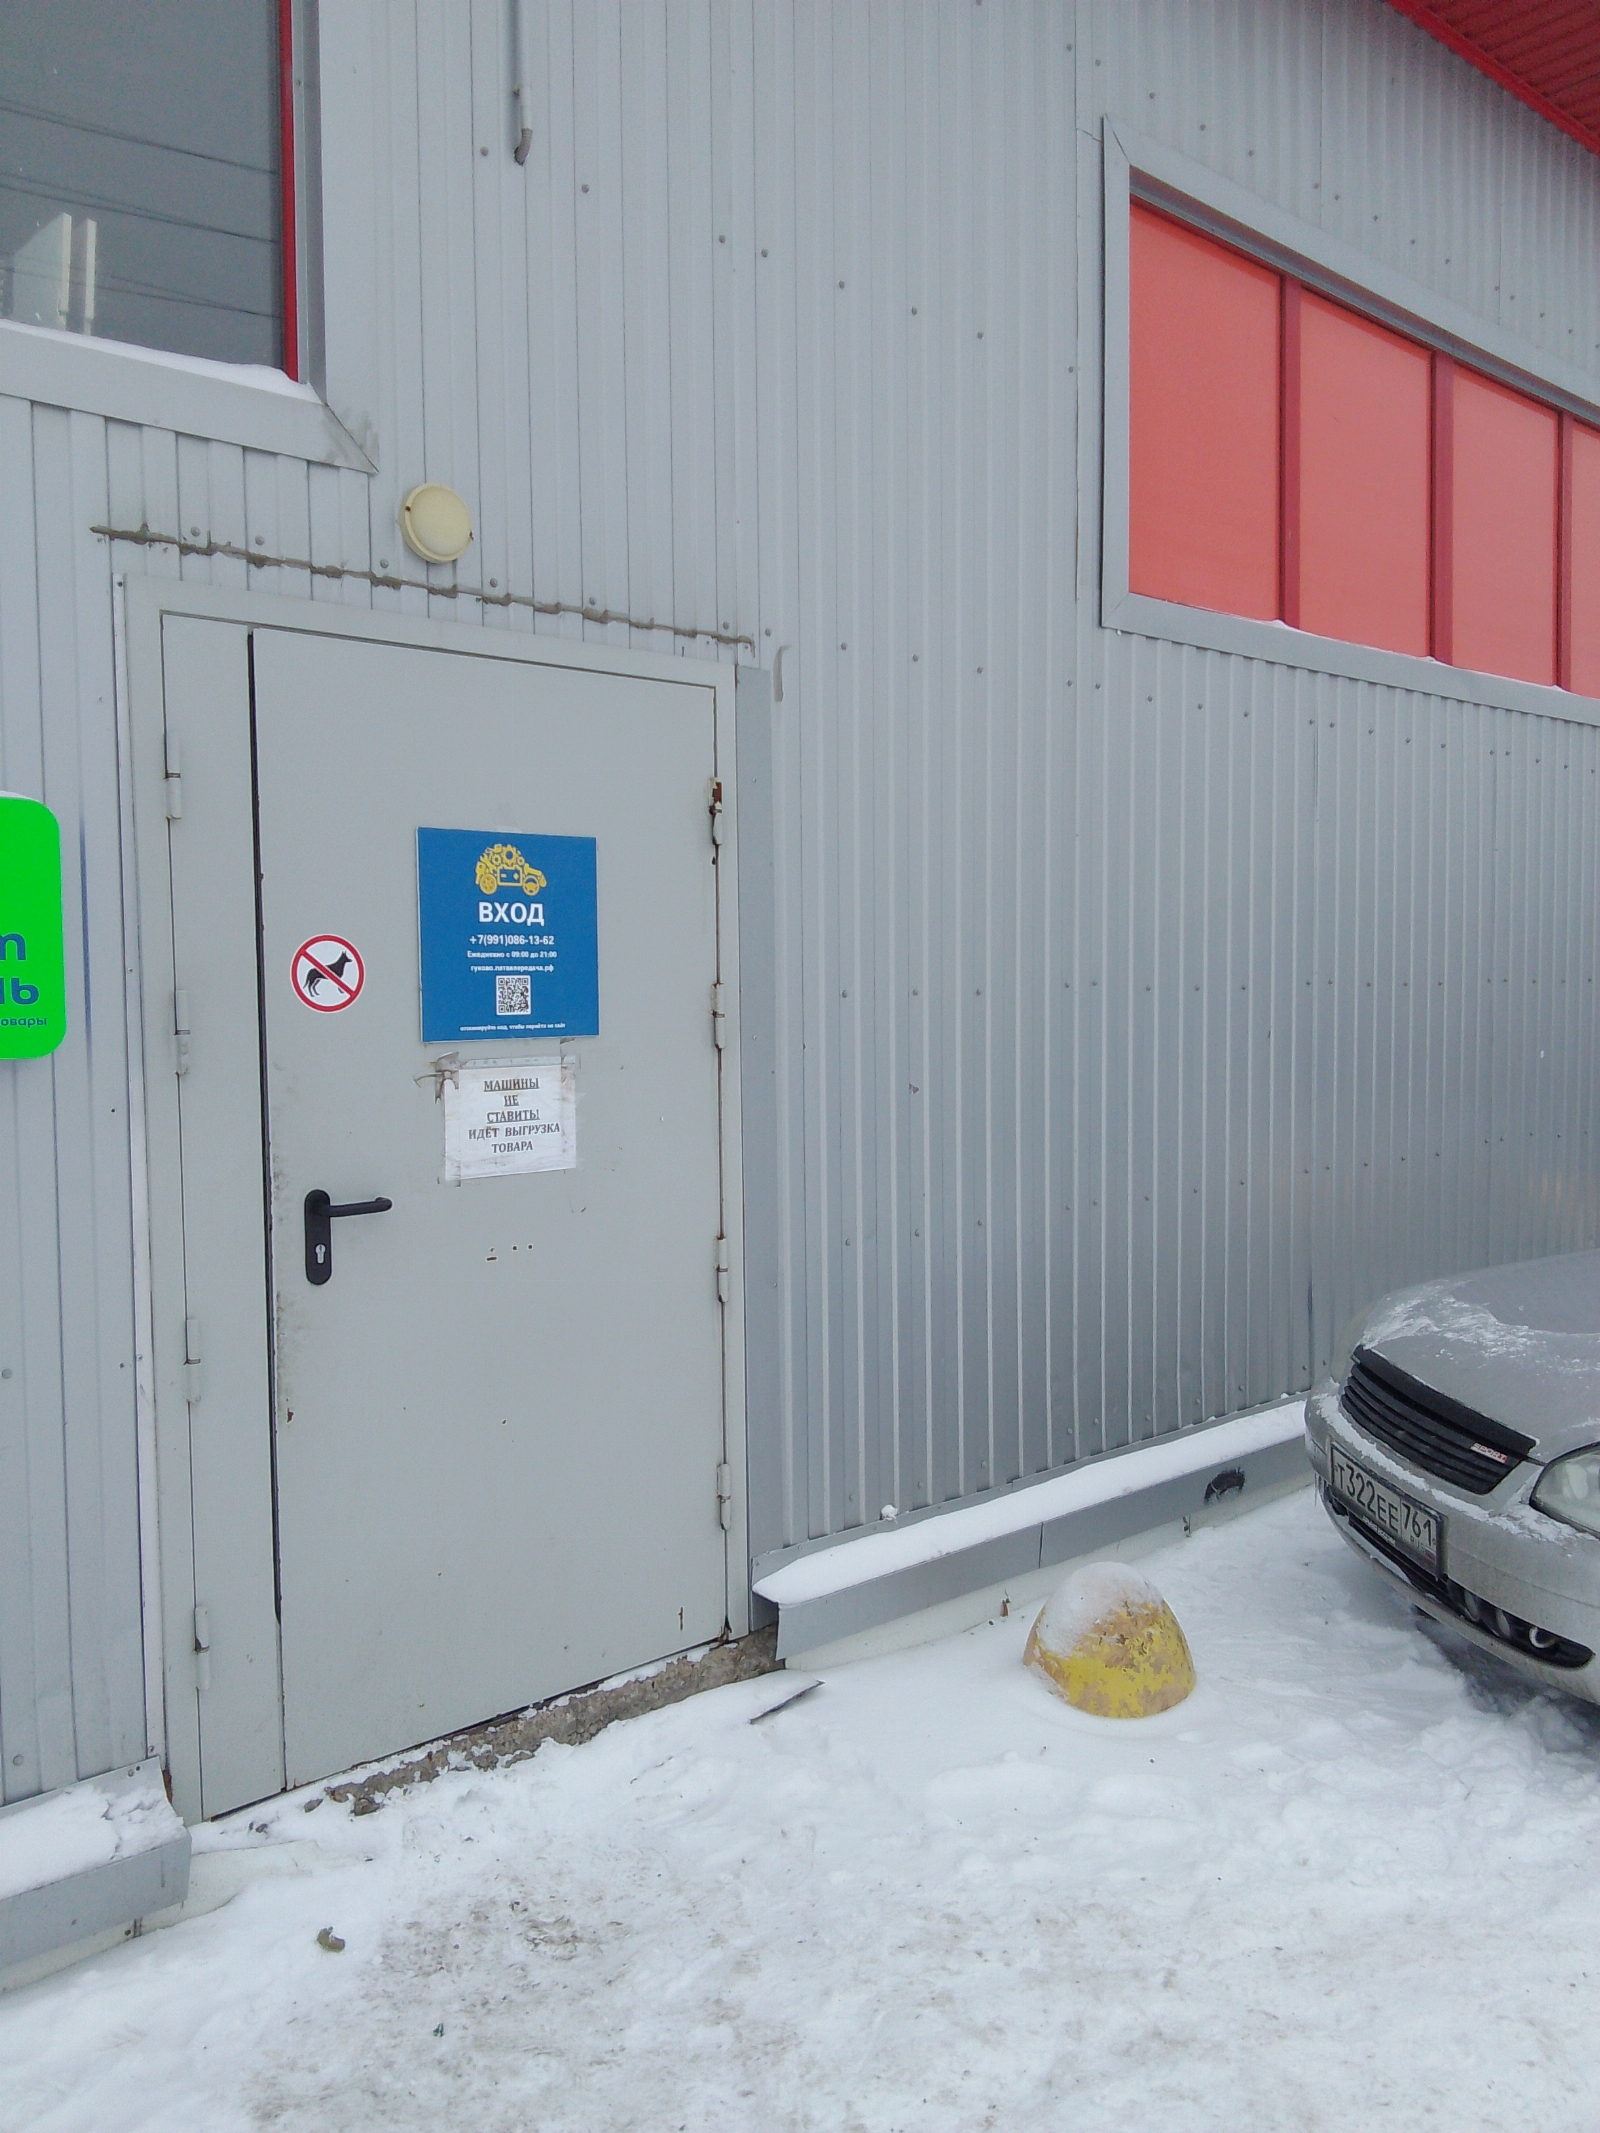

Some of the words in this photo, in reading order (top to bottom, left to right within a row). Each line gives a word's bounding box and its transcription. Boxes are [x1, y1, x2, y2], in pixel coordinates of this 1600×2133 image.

[478, 901, 545, 927] ВХОД
[469, 933, 555, 947] +7(991)086-13-62
[467, 950, 505, 958] Ежедневно
[540, 950, 558, 958] 21:00
[0, 1018, 47, 1029] овары
[484, 1078, 539, 1091] МАШИНЫ
[504, 1095, 519, 1106] НЕ
[487, 1109, 540, 1123] СТАВИТЬ!
[468, 1127, 499, 1141] ИДЁТ
[505, 1123, 560, 1137] ВЫГРУЗКА
[492, 1141, 533, 1153] ТОВАРА
[1402, 1502, 1433, 1547] 761
